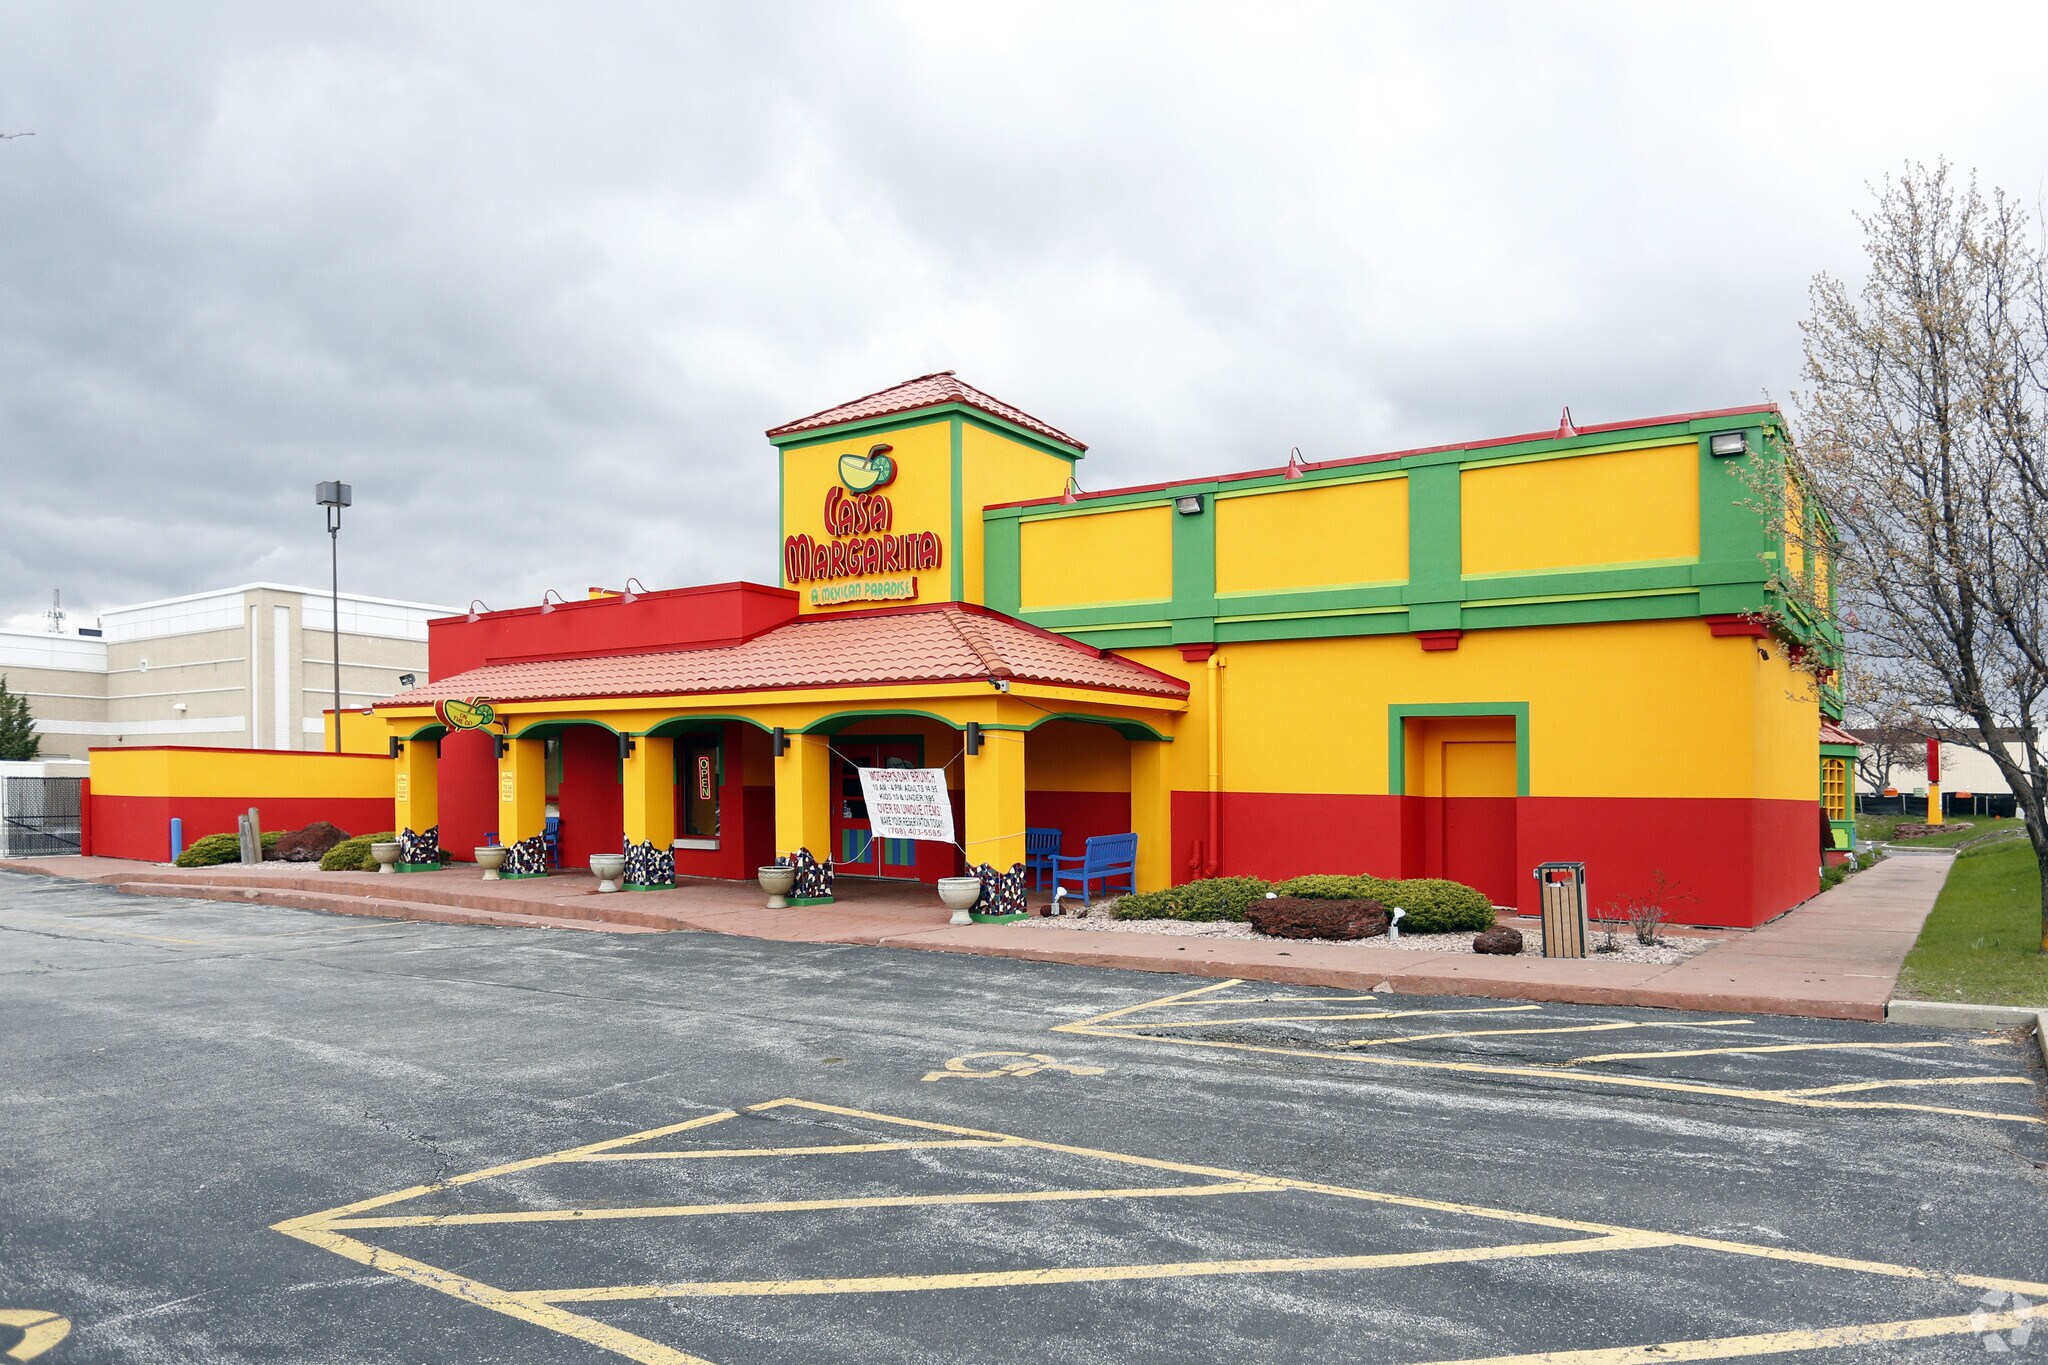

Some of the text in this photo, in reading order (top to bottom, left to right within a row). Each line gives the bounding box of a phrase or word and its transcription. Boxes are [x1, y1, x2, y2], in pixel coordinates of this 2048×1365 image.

[824, 486, 891, 537] CASA
[785, 531, 942, 583] MARGARITA
[811, 580, 911, 602] A MEXICAN PARADISE
[453, 715, 463, 725] THE
[460, 712, 468, 720] ON
[700, 759, 709, 797] OPEN
[868, 770, 936, 783] MOTHER'S DAY BRUNCH
[904, 784, 924, 793] ADULTS
[879, 793, 892, 801] KIDS
[905, 793, 923, 802] UNDER
[877, 803, 893, 814] OVER
[901, 803, 923, 816] UNIQUE
[902, 816, 930, 828] RESERVATION
[887, 827, 942, 837] (708) 403-5585
